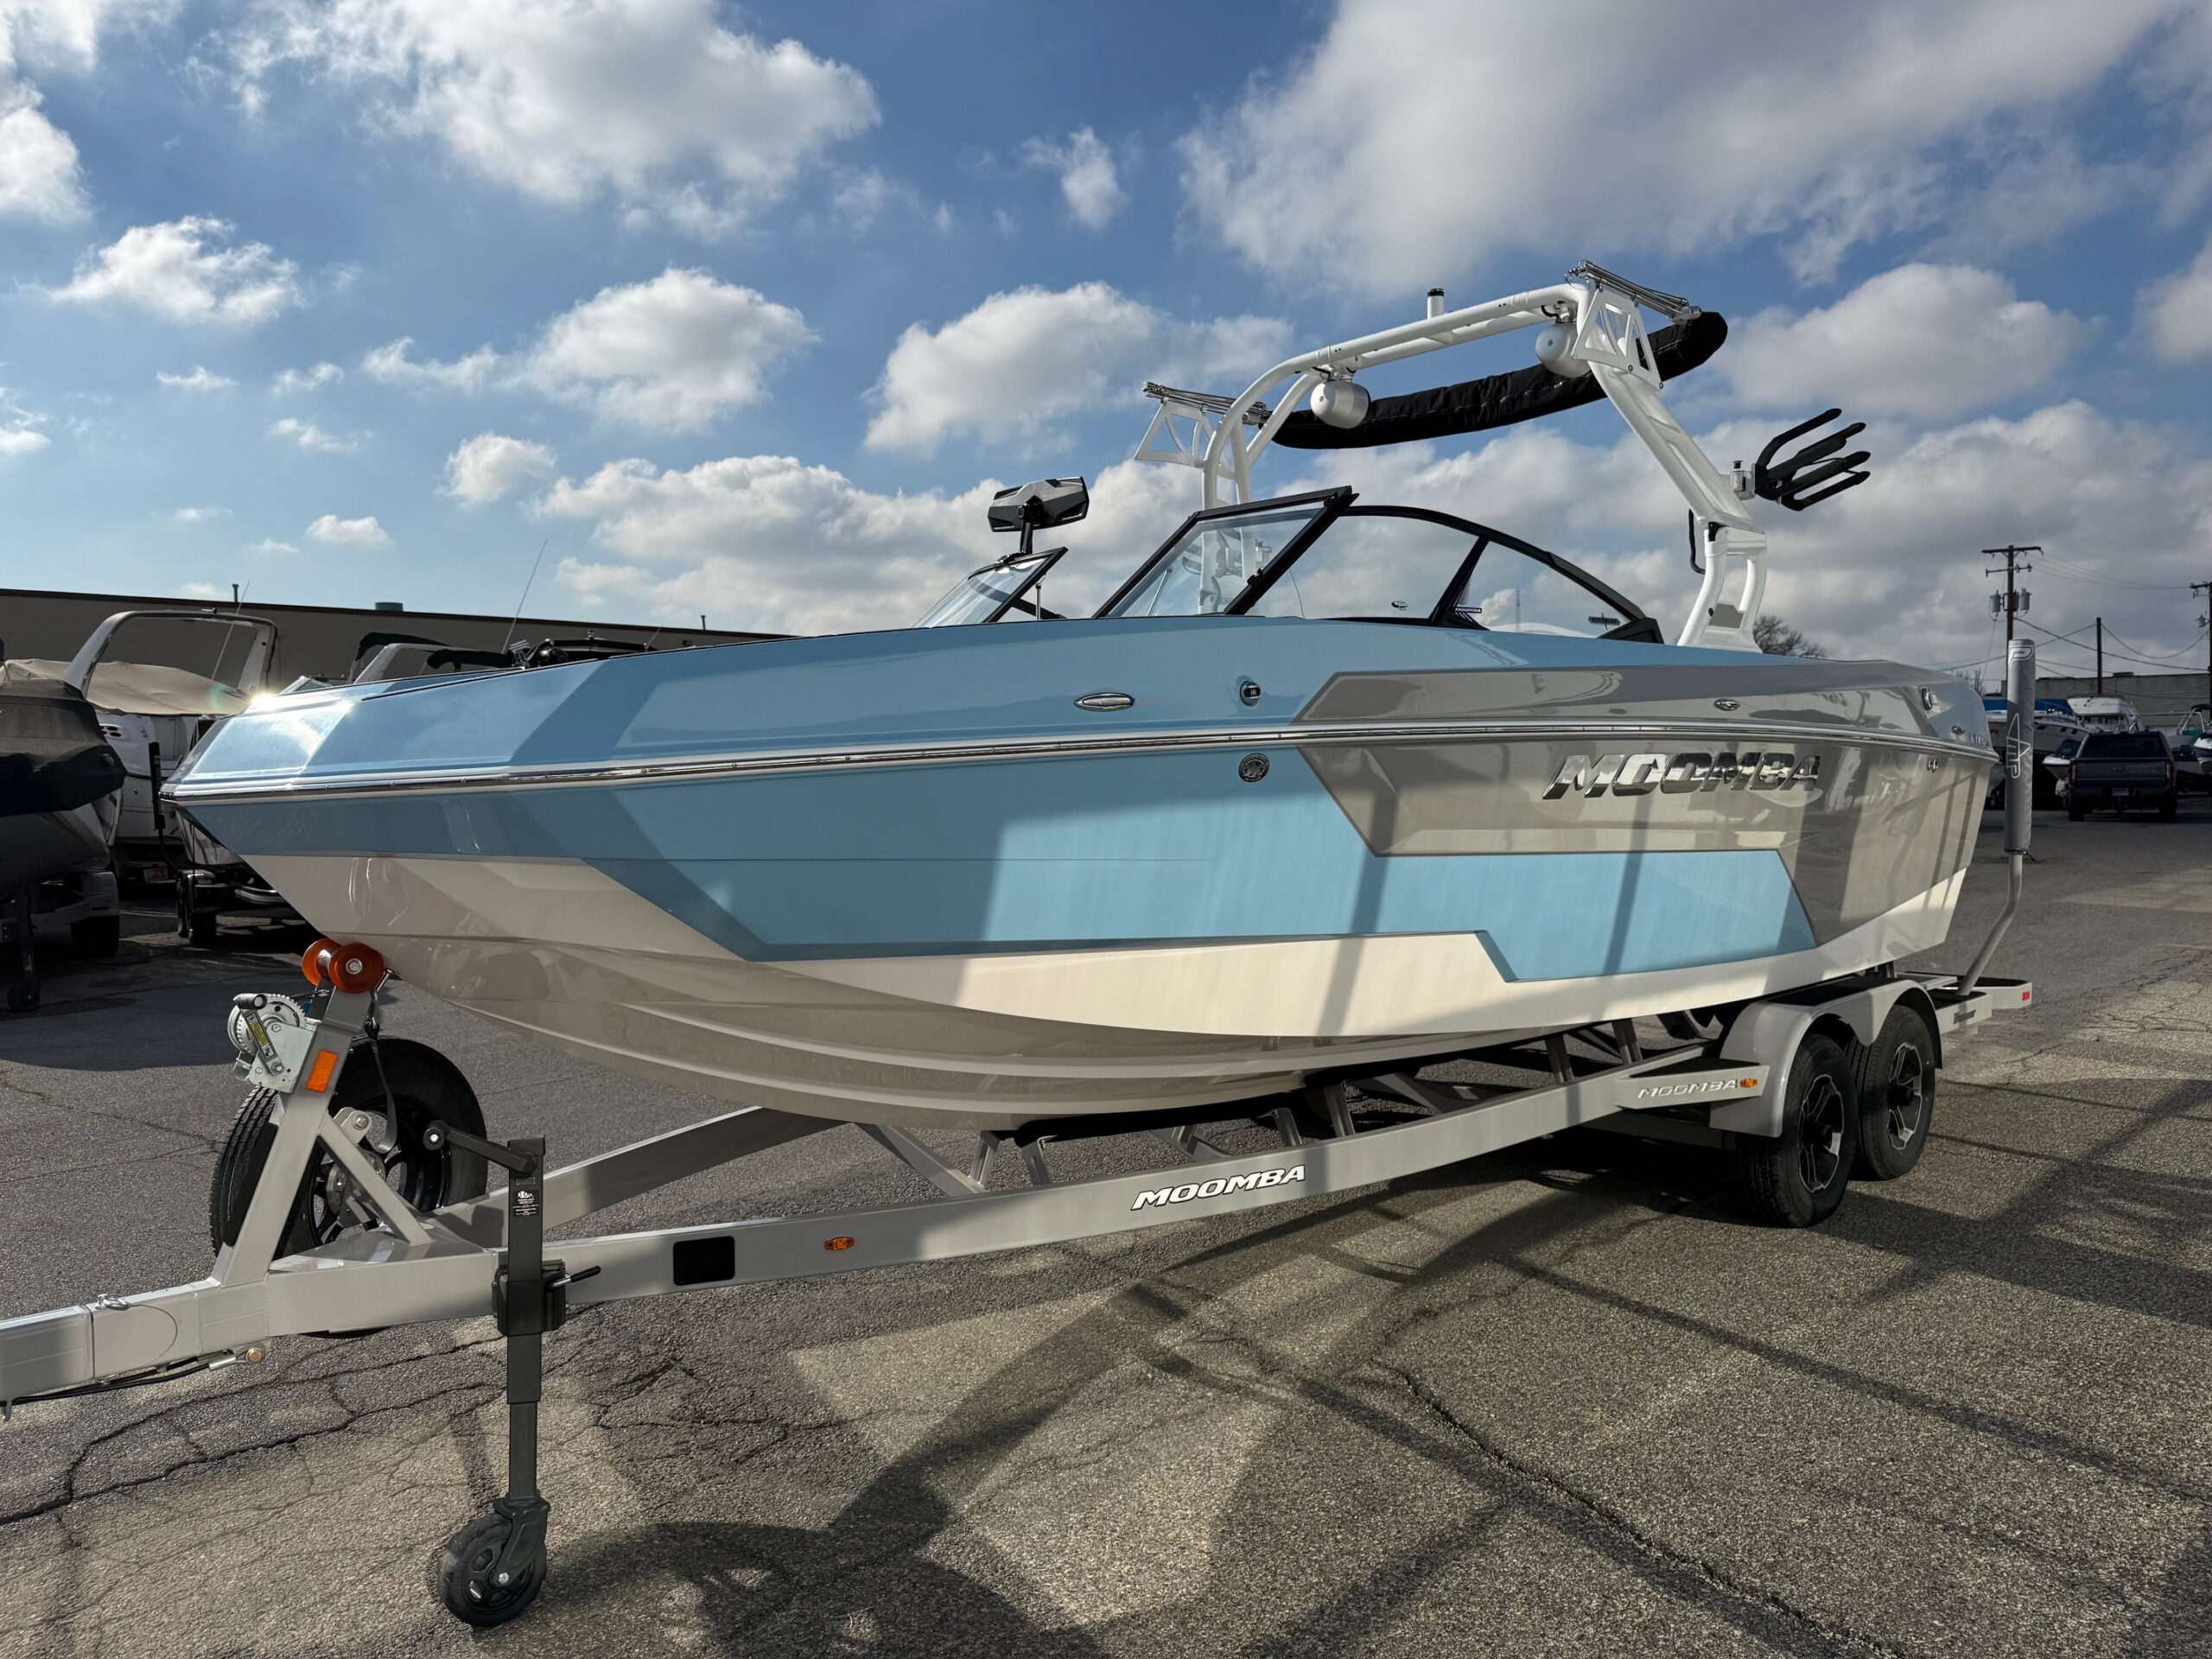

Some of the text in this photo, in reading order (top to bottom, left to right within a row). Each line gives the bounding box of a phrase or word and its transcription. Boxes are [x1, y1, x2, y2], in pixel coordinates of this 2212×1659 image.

[1542, 752, 1821, 800] MOOMBA
[1637, 1079, 1737, 1098] MOOMBA
[1130, 1164, 1305, 1211] MOOMBA
